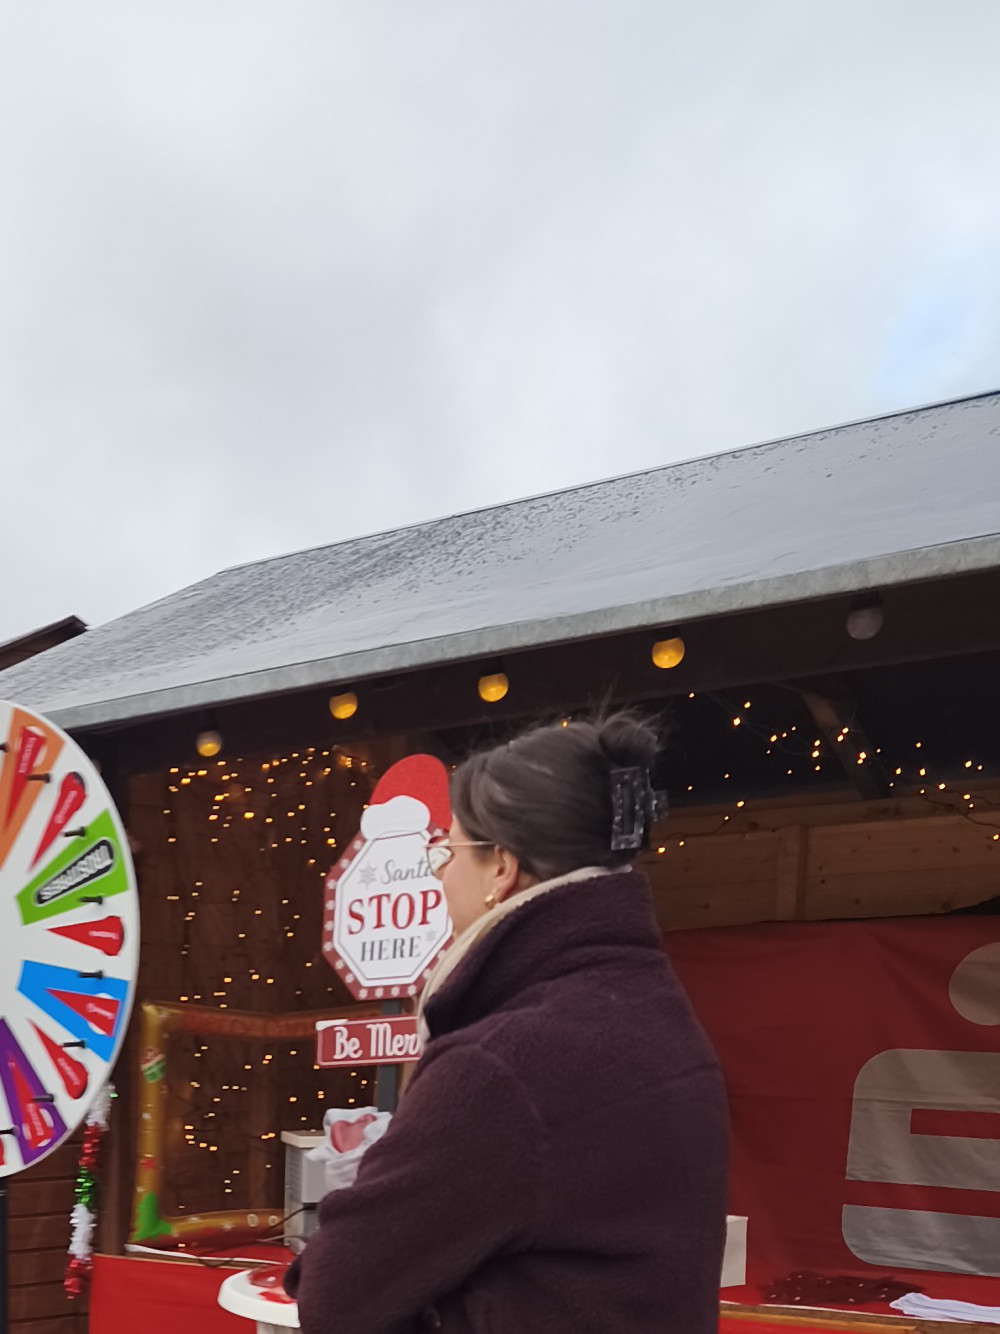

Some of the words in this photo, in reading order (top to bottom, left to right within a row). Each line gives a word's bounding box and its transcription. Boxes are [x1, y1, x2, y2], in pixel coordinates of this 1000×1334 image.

[348, 889, 441, 935] STOP
[361, 936, 421, 961] HERE
[333, 1027, 363, 1060] Be
